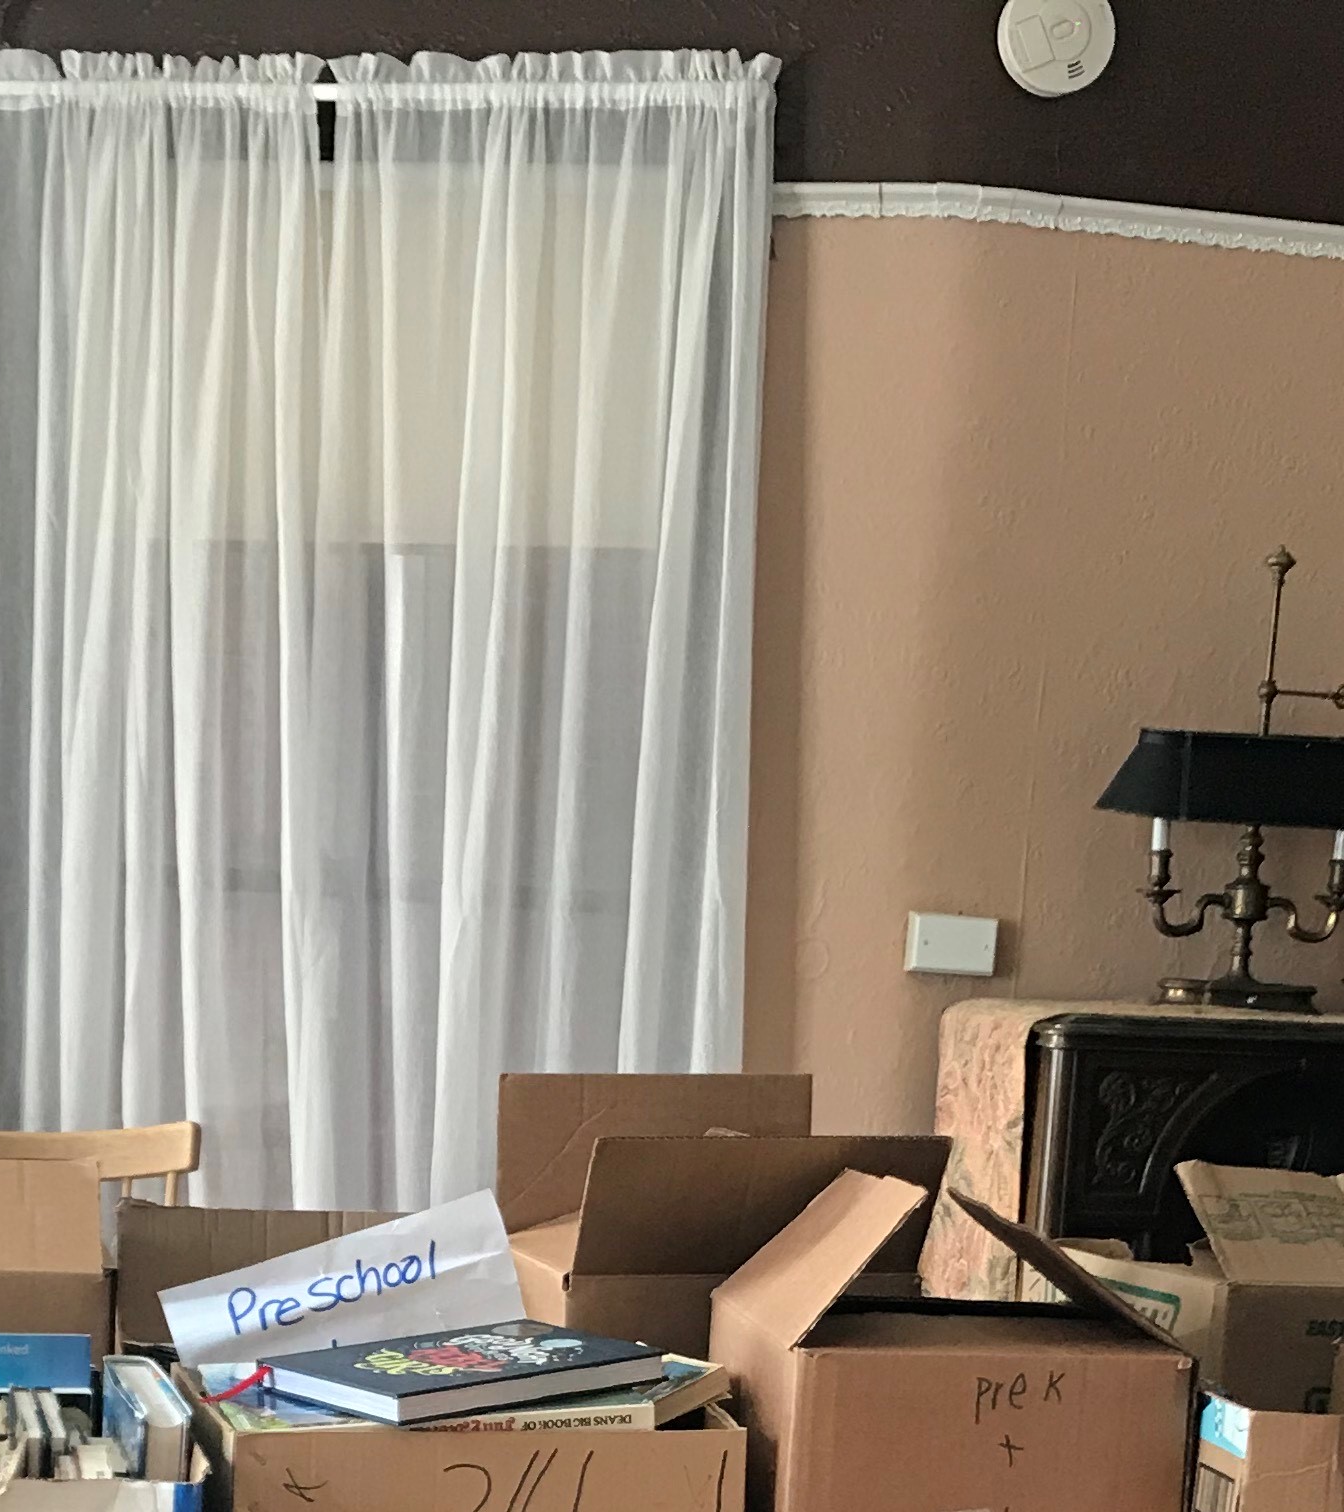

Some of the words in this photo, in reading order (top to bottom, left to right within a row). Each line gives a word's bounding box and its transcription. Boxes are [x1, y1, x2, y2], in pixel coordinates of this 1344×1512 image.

[975, 1372, 1025, 1425] pre
[537, 1417, 571, 1431] BOOK
[594, 1413, 632, 1427] DEANS
